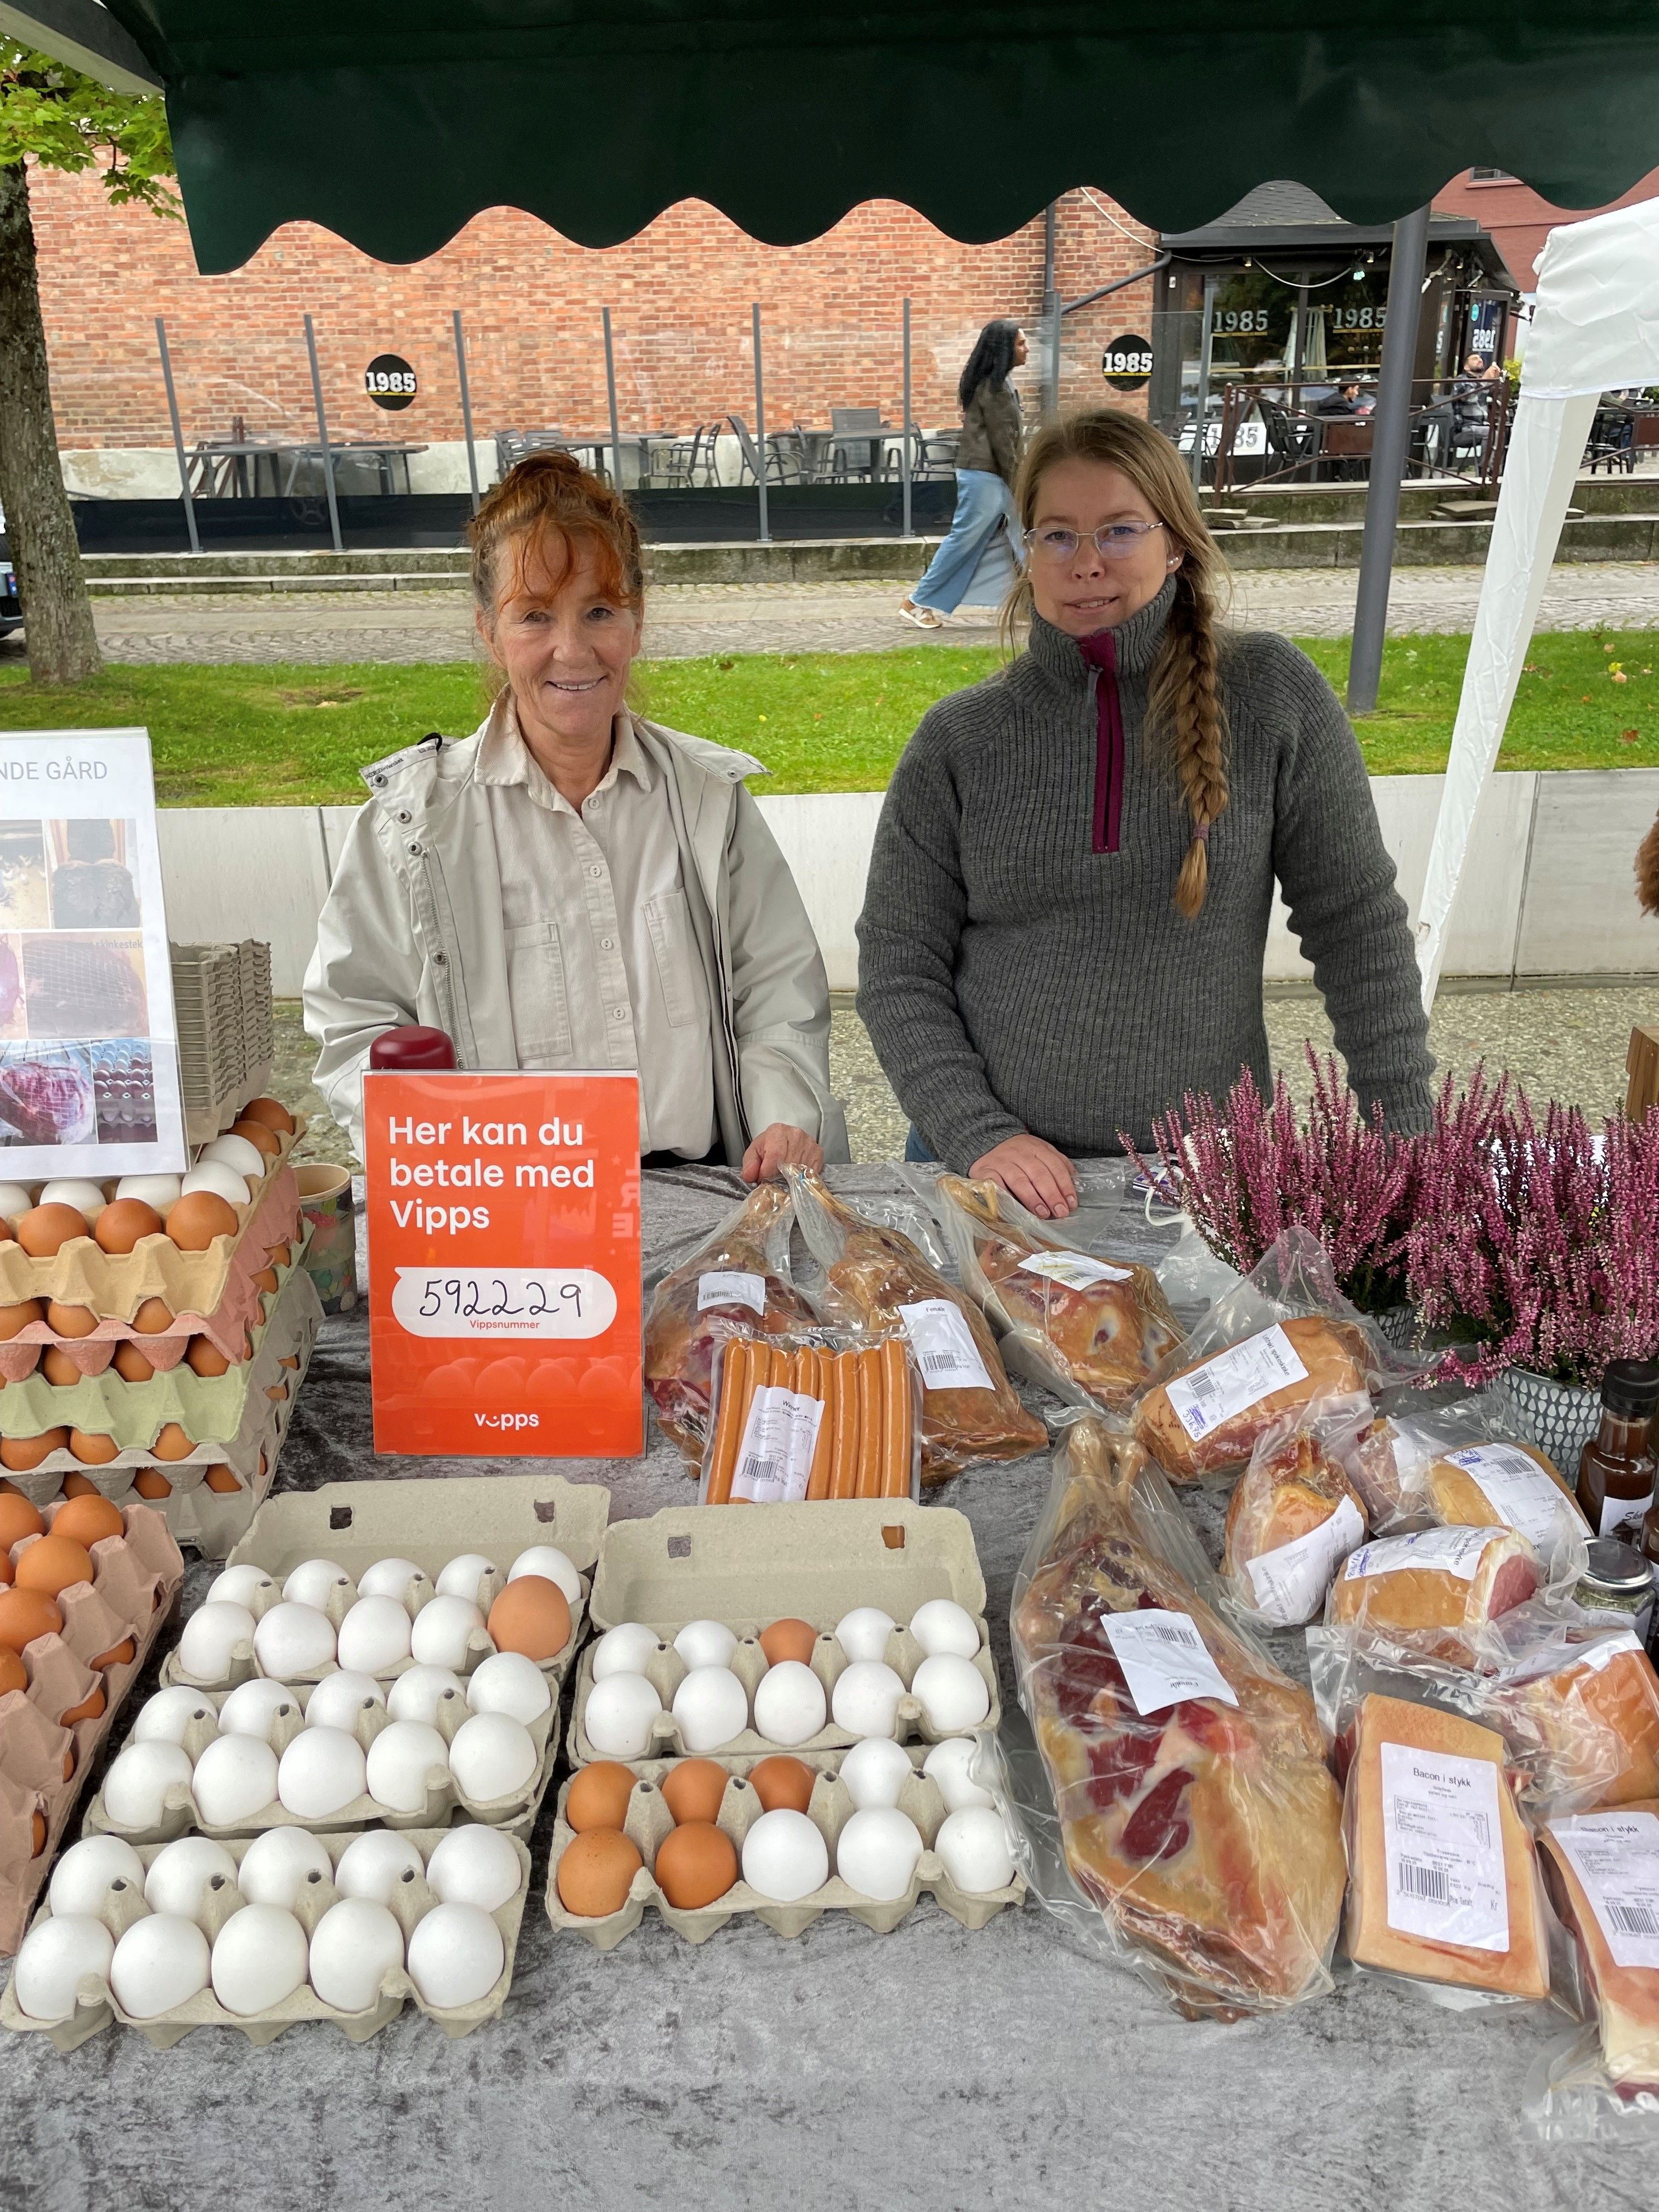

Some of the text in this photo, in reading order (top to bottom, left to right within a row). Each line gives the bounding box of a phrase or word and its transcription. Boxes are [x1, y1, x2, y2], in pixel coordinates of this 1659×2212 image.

[1213, 310, 1268, 332] 1985
[1333, 307, 1387, 329] 1985
[1103, 353, 1153, 373] 1985
[366, 372, 416, 392] 1985
[1210, 427, 1257, 448] 185
[46, 756, 108, 780] GÅRD
[389, 1116, 583, 1146] Her kan du
[391, 1158, 594, 1188] betale med
[390, 1198, 489, 1235] Vipps
[419, 1279, 582, 1317] 592229
[470, 1320, 539, 1330] Vippsnummer
[782, 1400, 800, 1412] Wiener
[1413, 1767, 1471, 1787] Bacon i stykk
[1617, 1826, 1640, 1834] stykk
